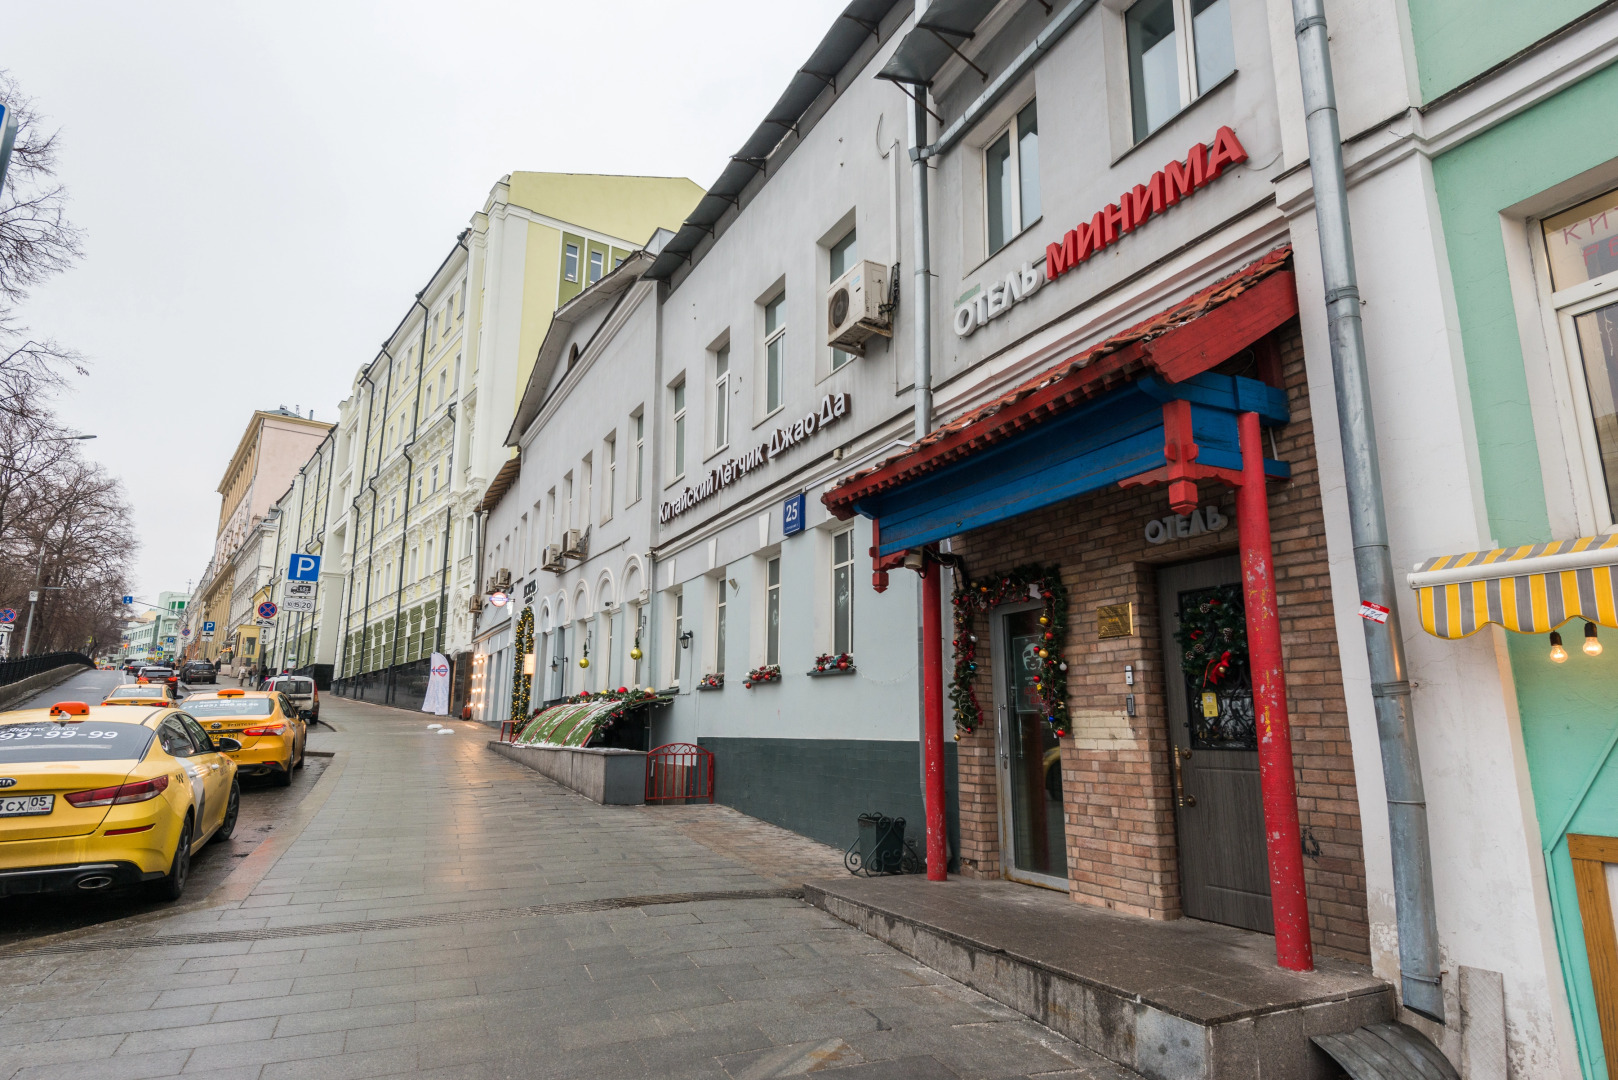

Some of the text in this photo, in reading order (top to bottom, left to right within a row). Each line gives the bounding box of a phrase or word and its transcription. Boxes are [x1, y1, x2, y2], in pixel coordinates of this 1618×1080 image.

[954, 125, 1249, 337] ОТЕЛЬ МИНИМА
[1563, 206, 1618, 245] КИ
[659, 392, 850, 524] Китайский Лётчик Джао Да
[786, 502, 798, 522] 25
[1145, 506, 1228, 544] ОТЕЛЬ
[296, 557, 315, 578] P
[31, 797, 47, 807] 05
